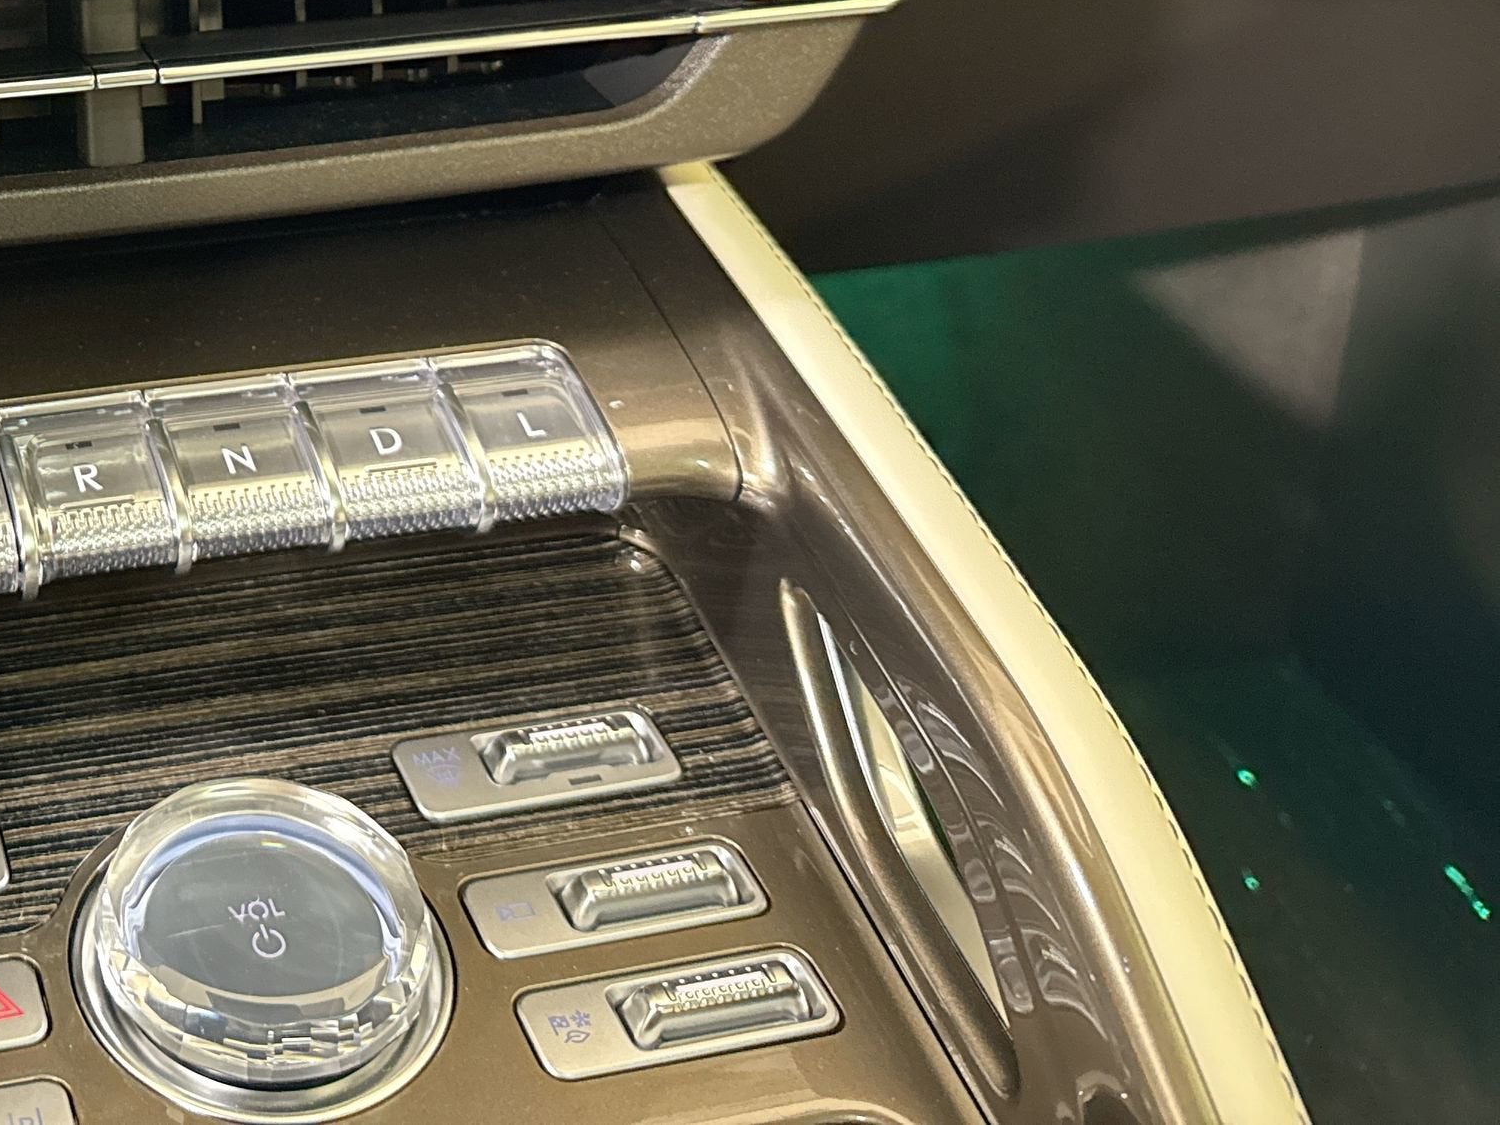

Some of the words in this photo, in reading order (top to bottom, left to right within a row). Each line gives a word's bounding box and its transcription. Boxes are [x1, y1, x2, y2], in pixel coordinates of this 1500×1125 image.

[73, 464, 103, 492] R
[221, 445, 257, 475] N
[369, 427, 403, 456] D
[516, 412, 548, 438] L
[228, 897, 285, 922] VOL
